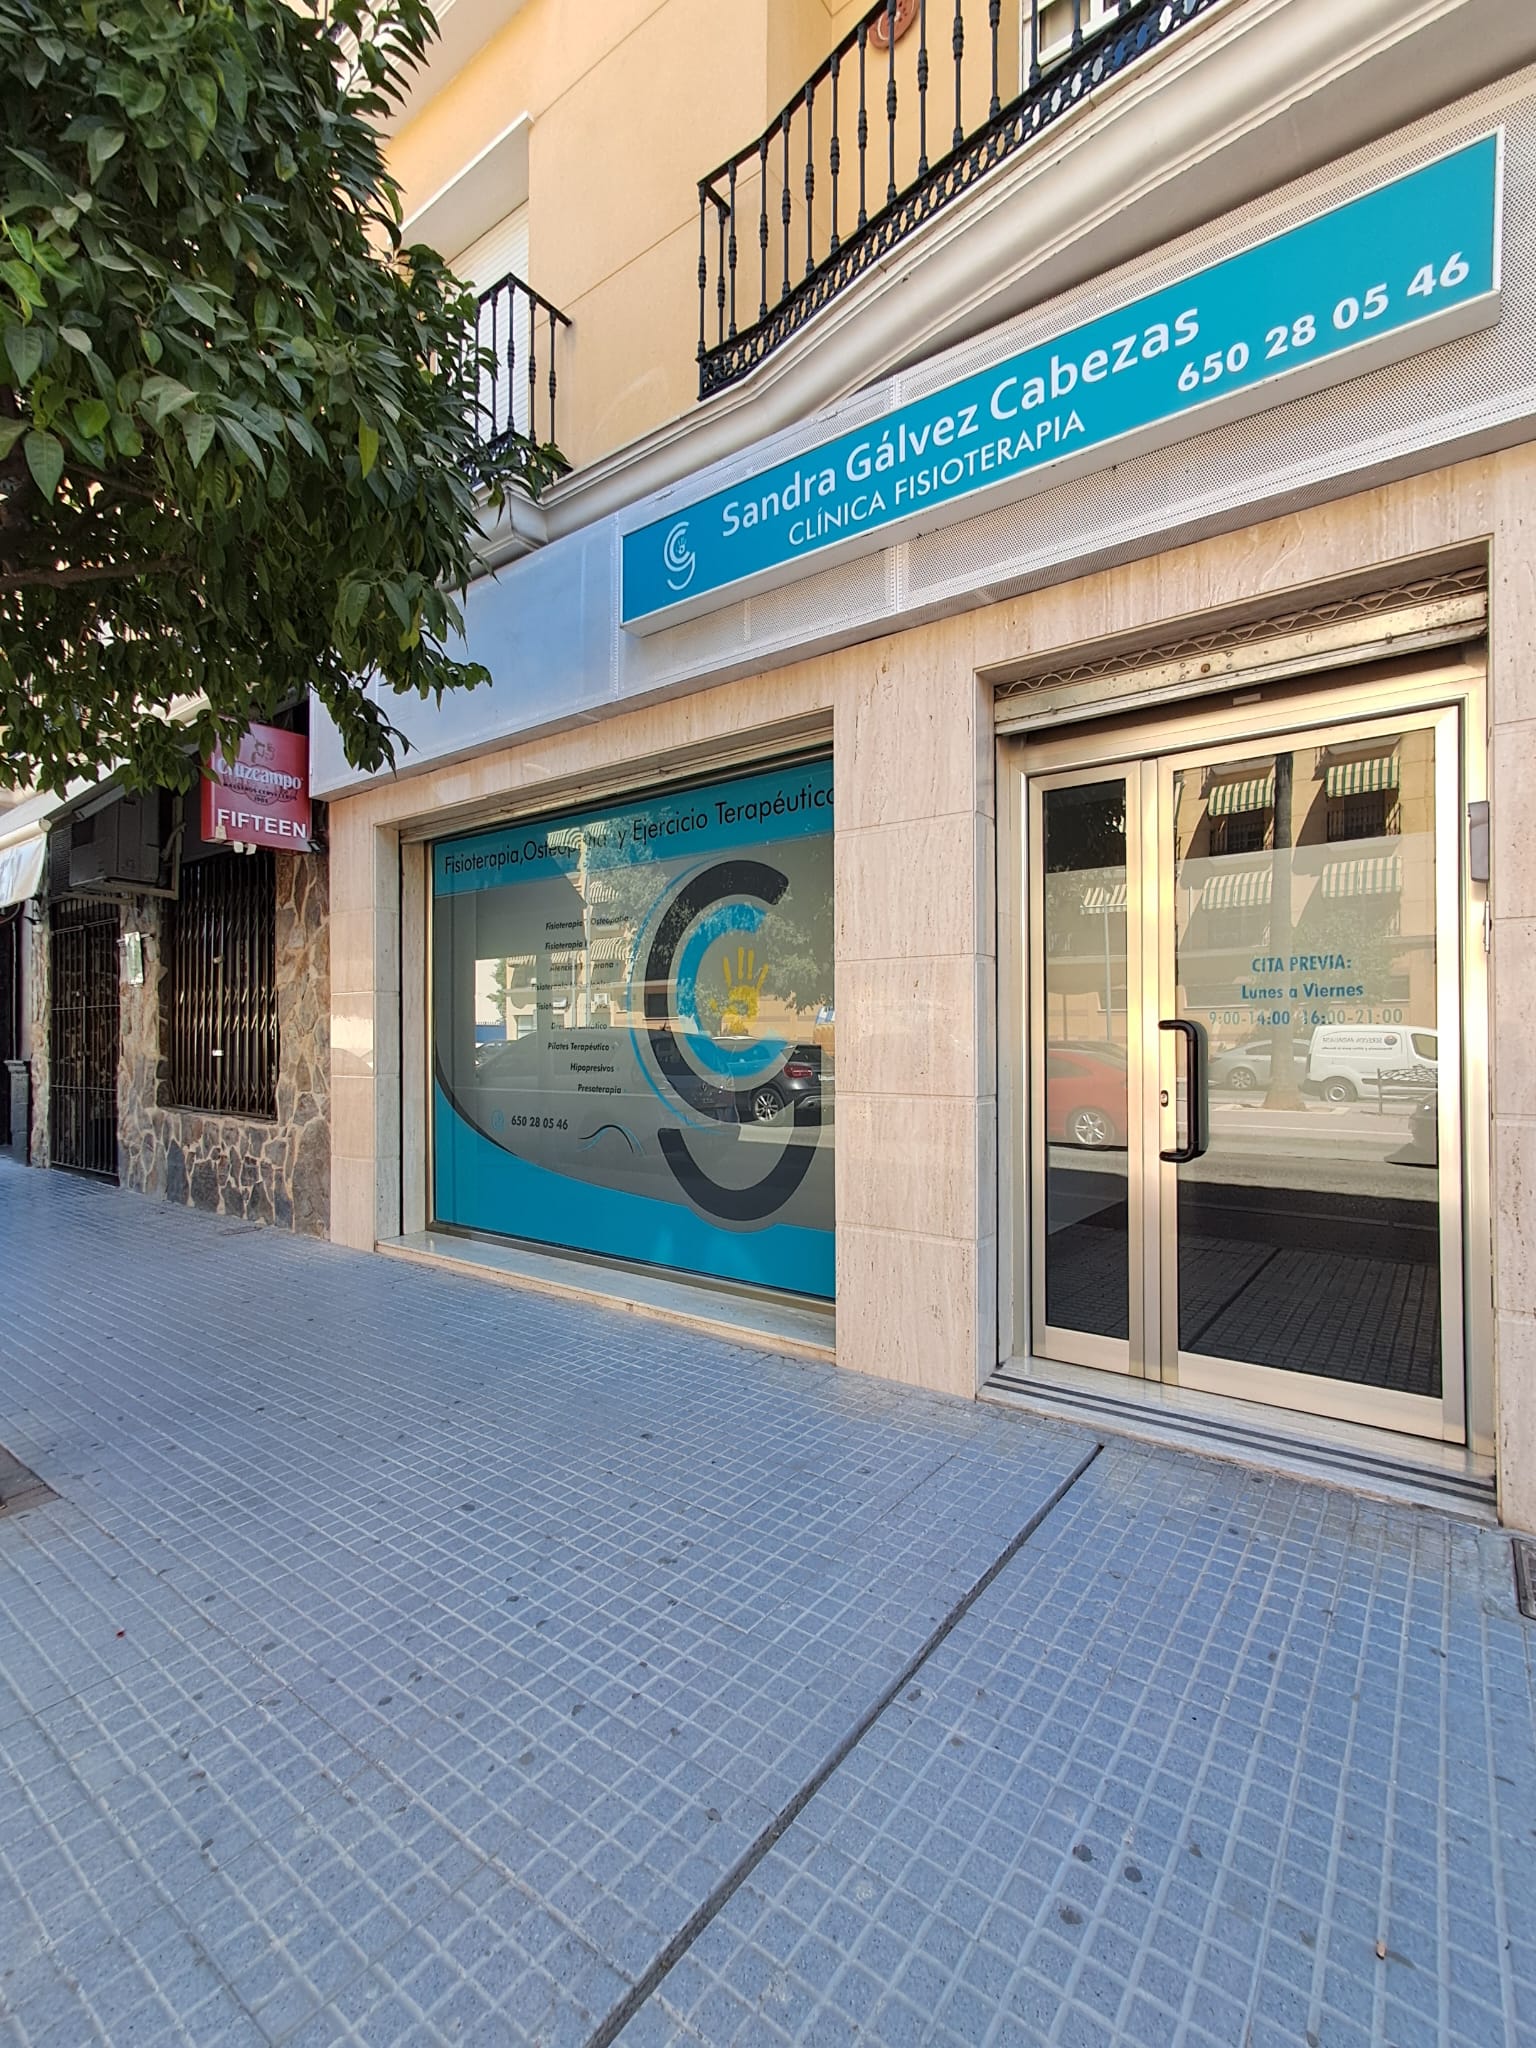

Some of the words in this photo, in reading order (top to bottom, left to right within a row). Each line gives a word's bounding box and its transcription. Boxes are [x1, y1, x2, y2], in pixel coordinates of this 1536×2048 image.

[1177, 342, 1250, 392] 650
[1265, 314, 1316, 360] 28
[1332, 282, 1389, 330] 05
[1406, 251, 1470, 297] 46
[722, 468, 836, 537] Sandra
[846, 404, 979, 482] Gálvez
[990, 307, 1200, 420] Cabezas
[789, 490, 886, 546] CLÍNICA
[894, 409, 1086, 506] FISIOTERAPIA
[217, 808, 307, 838] FIFTEEN
[633, 808, 708, 845] Ejercicio
[1251, 957, 1284, 973] CITA
[1289, 953, 1352, 972] PREVIA:
[1241, 984, 1283, 1000] Lunes
[1289, 987, 1298, 999] a
[1303, 982, 1364, 998] Viernes
[511, 1115, 527, 1127] 650
[529, 1116, 541, 1128] 28
[543, 1117, 554, 1129] 05
[556, 1118, 569, 1131] 46
